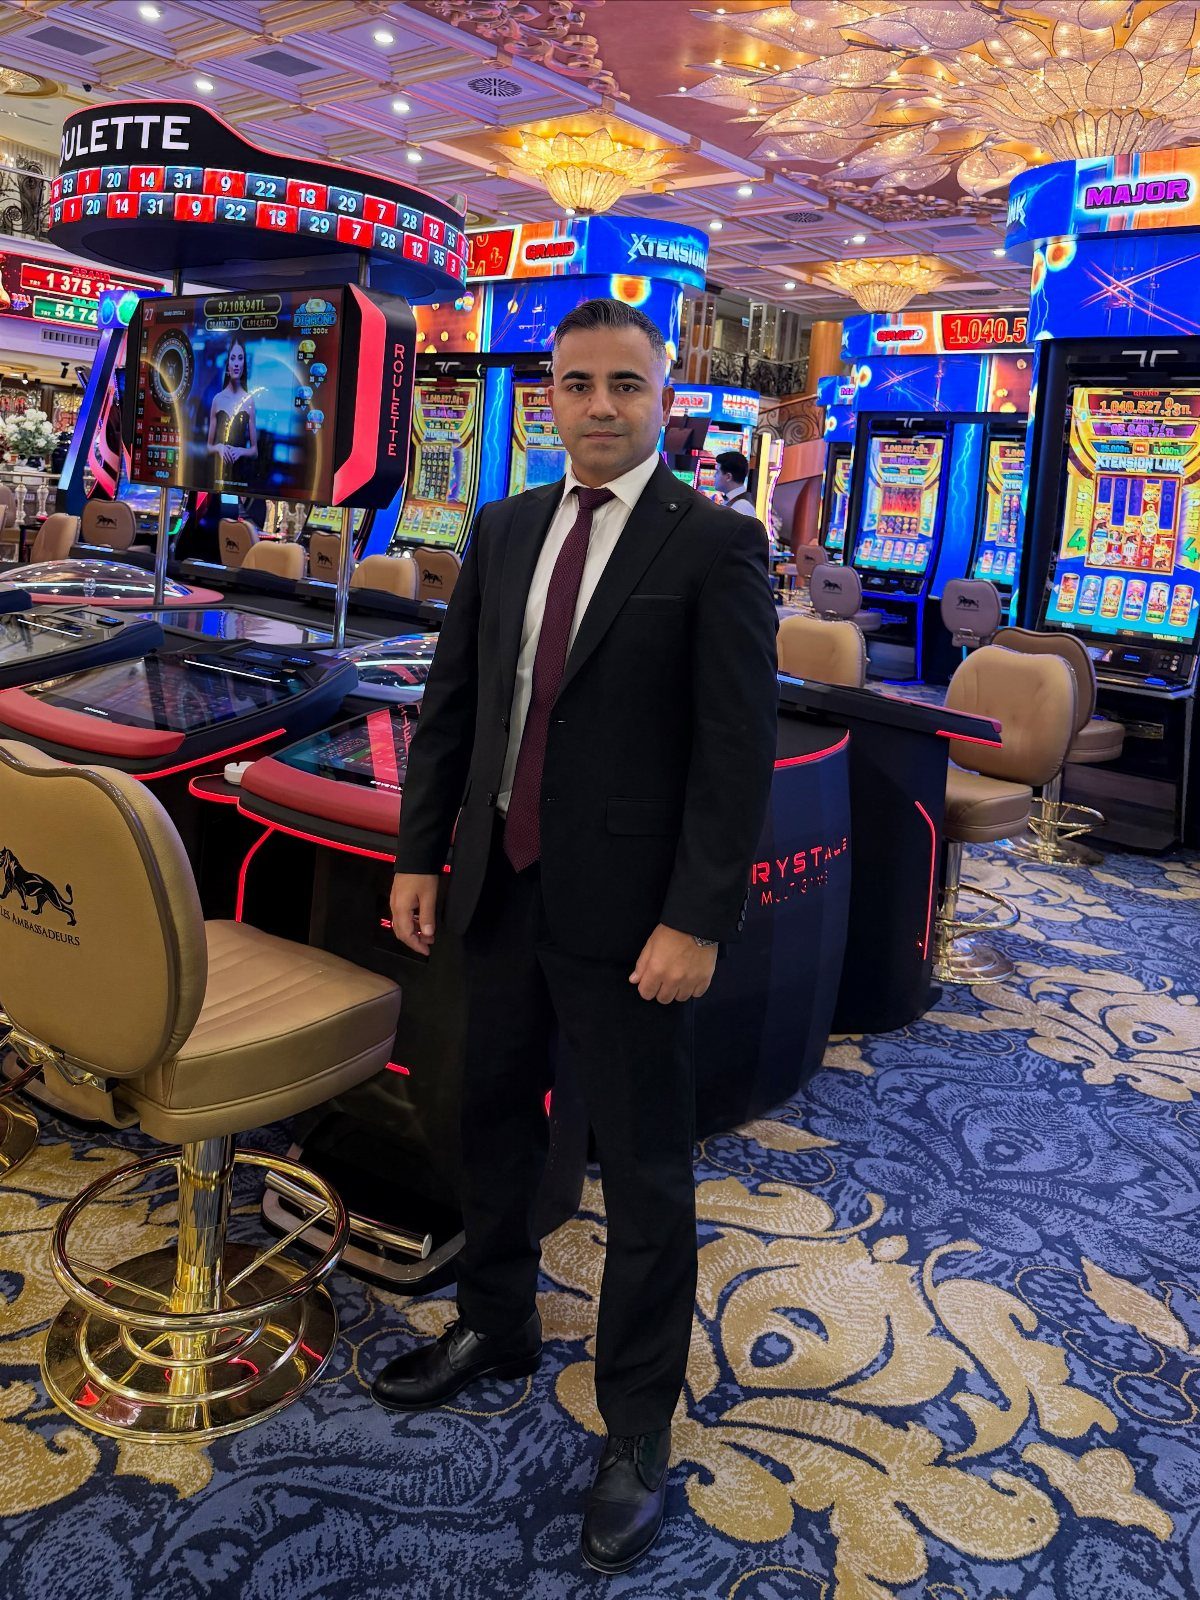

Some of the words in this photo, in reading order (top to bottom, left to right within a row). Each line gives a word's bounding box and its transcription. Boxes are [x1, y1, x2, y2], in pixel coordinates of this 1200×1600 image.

[1085, 178, 1190, 209] MAJOR
[62, 178, 74, 194] 33
[84, 175, 91, 190] 1
[106, 172, 122, 188] 20
[139, 172, 155, 188] 14
[173, 173, 192, 189] 31
[220, 176, 232, 192] 9
[254, 180, 277, 198] 22
[298, 187, 316, 205] 18
[337, 195, 357, 213] 29
[377, 203, 387, 220] 7
[402, 212, 418, 230] 28
[428, 222, 439, 240] 12
[447, 231, 456, 248] 35
[70, 202, 75, 217] 1
[86, 199, 101, 215] 20
[115, 198, 129, 214] 14
[147, 199, 164, 215] 31
[191, 200, 202, 216] 9
[224, 203, 247, 221] 22
[269, 209, 287, 227] 18
[309, 215, 330, 234] 29
[352, 224, 361, 240] 7
[380, 231, 396, 250] 28
[411, 241, 423, 258] 12
[433, 249, 445, 267] 35
[451, 260, 456, 273] 3
[525, 241, 576, 261] GRAND
[46, 273, 55, 288] 1
[60, 275, 92, 295] 375
[55, 303, 75, 320] 54
[144, 308, 154, 321] 27
[293, 313, 337, 327] DIAMOND
[876, 329, 924, 343] GRAND
[950, 317, 1028, 344] 1.040.5
[388, 343, 405, 456] ROULETTE
[155, 470, 170, 479] COLD
[1095, 455, 1154, 471] XTENSION
[1155, 458, 1185, 476] LINK
[867, 513, 877, 528] 3
[921, 517, 931, 532] 3
[1067, 528, 1087, 551] 4
[1182, 537, 1200, 563] 4
[12, 912, 80, 946] AMBASSADEURS
